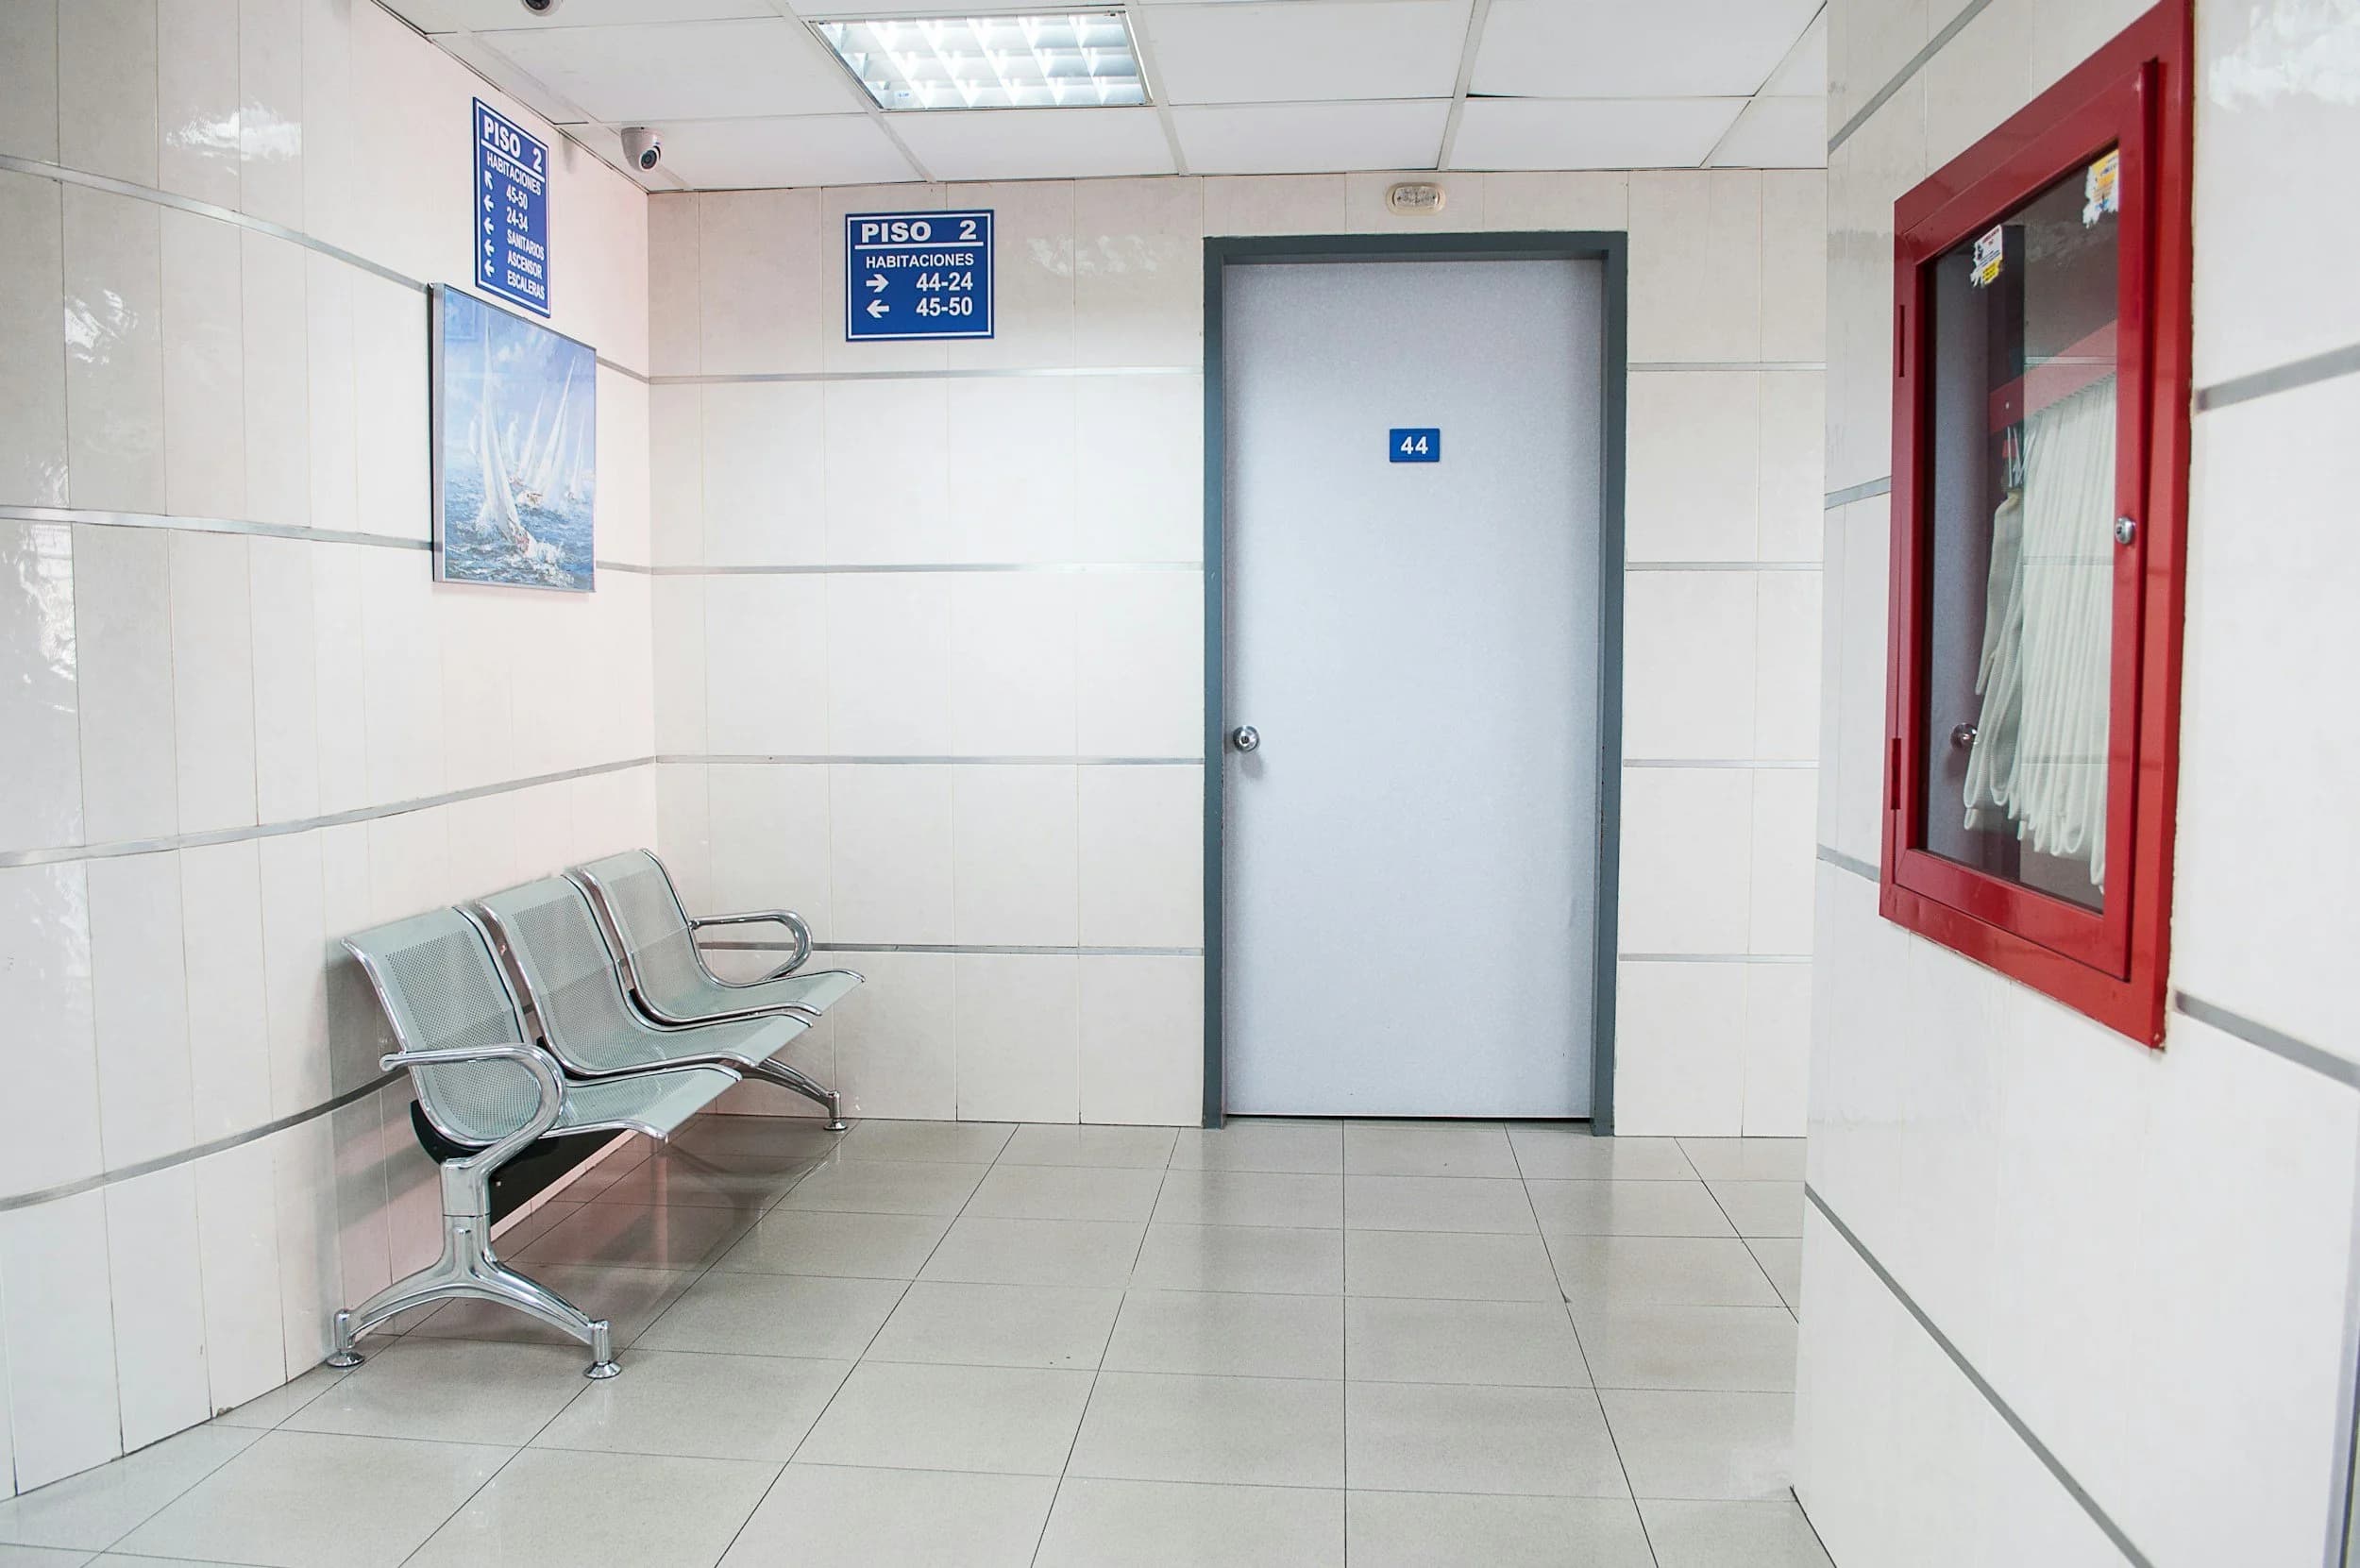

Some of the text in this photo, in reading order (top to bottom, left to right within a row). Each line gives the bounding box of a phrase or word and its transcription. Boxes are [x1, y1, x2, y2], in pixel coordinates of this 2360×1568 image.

[483, 114, 543, 173] PISO 2
[486, 150, 542, 196] HABITACIONES
[506, 183, 529, 210] 45-50
[506, 206, 529, 232] 24-34
[861, 220, 977, 244] PISO 2
[506, 228, 545, 261] SANITARIOS
[507, 250, 543, 279] ASCENSOR
[865, 253, 974, 269] HABITACIONES
[507, 269, 545, 300] ESCALERAS
[916, 272, 973, 292] 44-24
[916, 296, 973, 316] 45-50
[1400, 436, 1428, 455] 44
